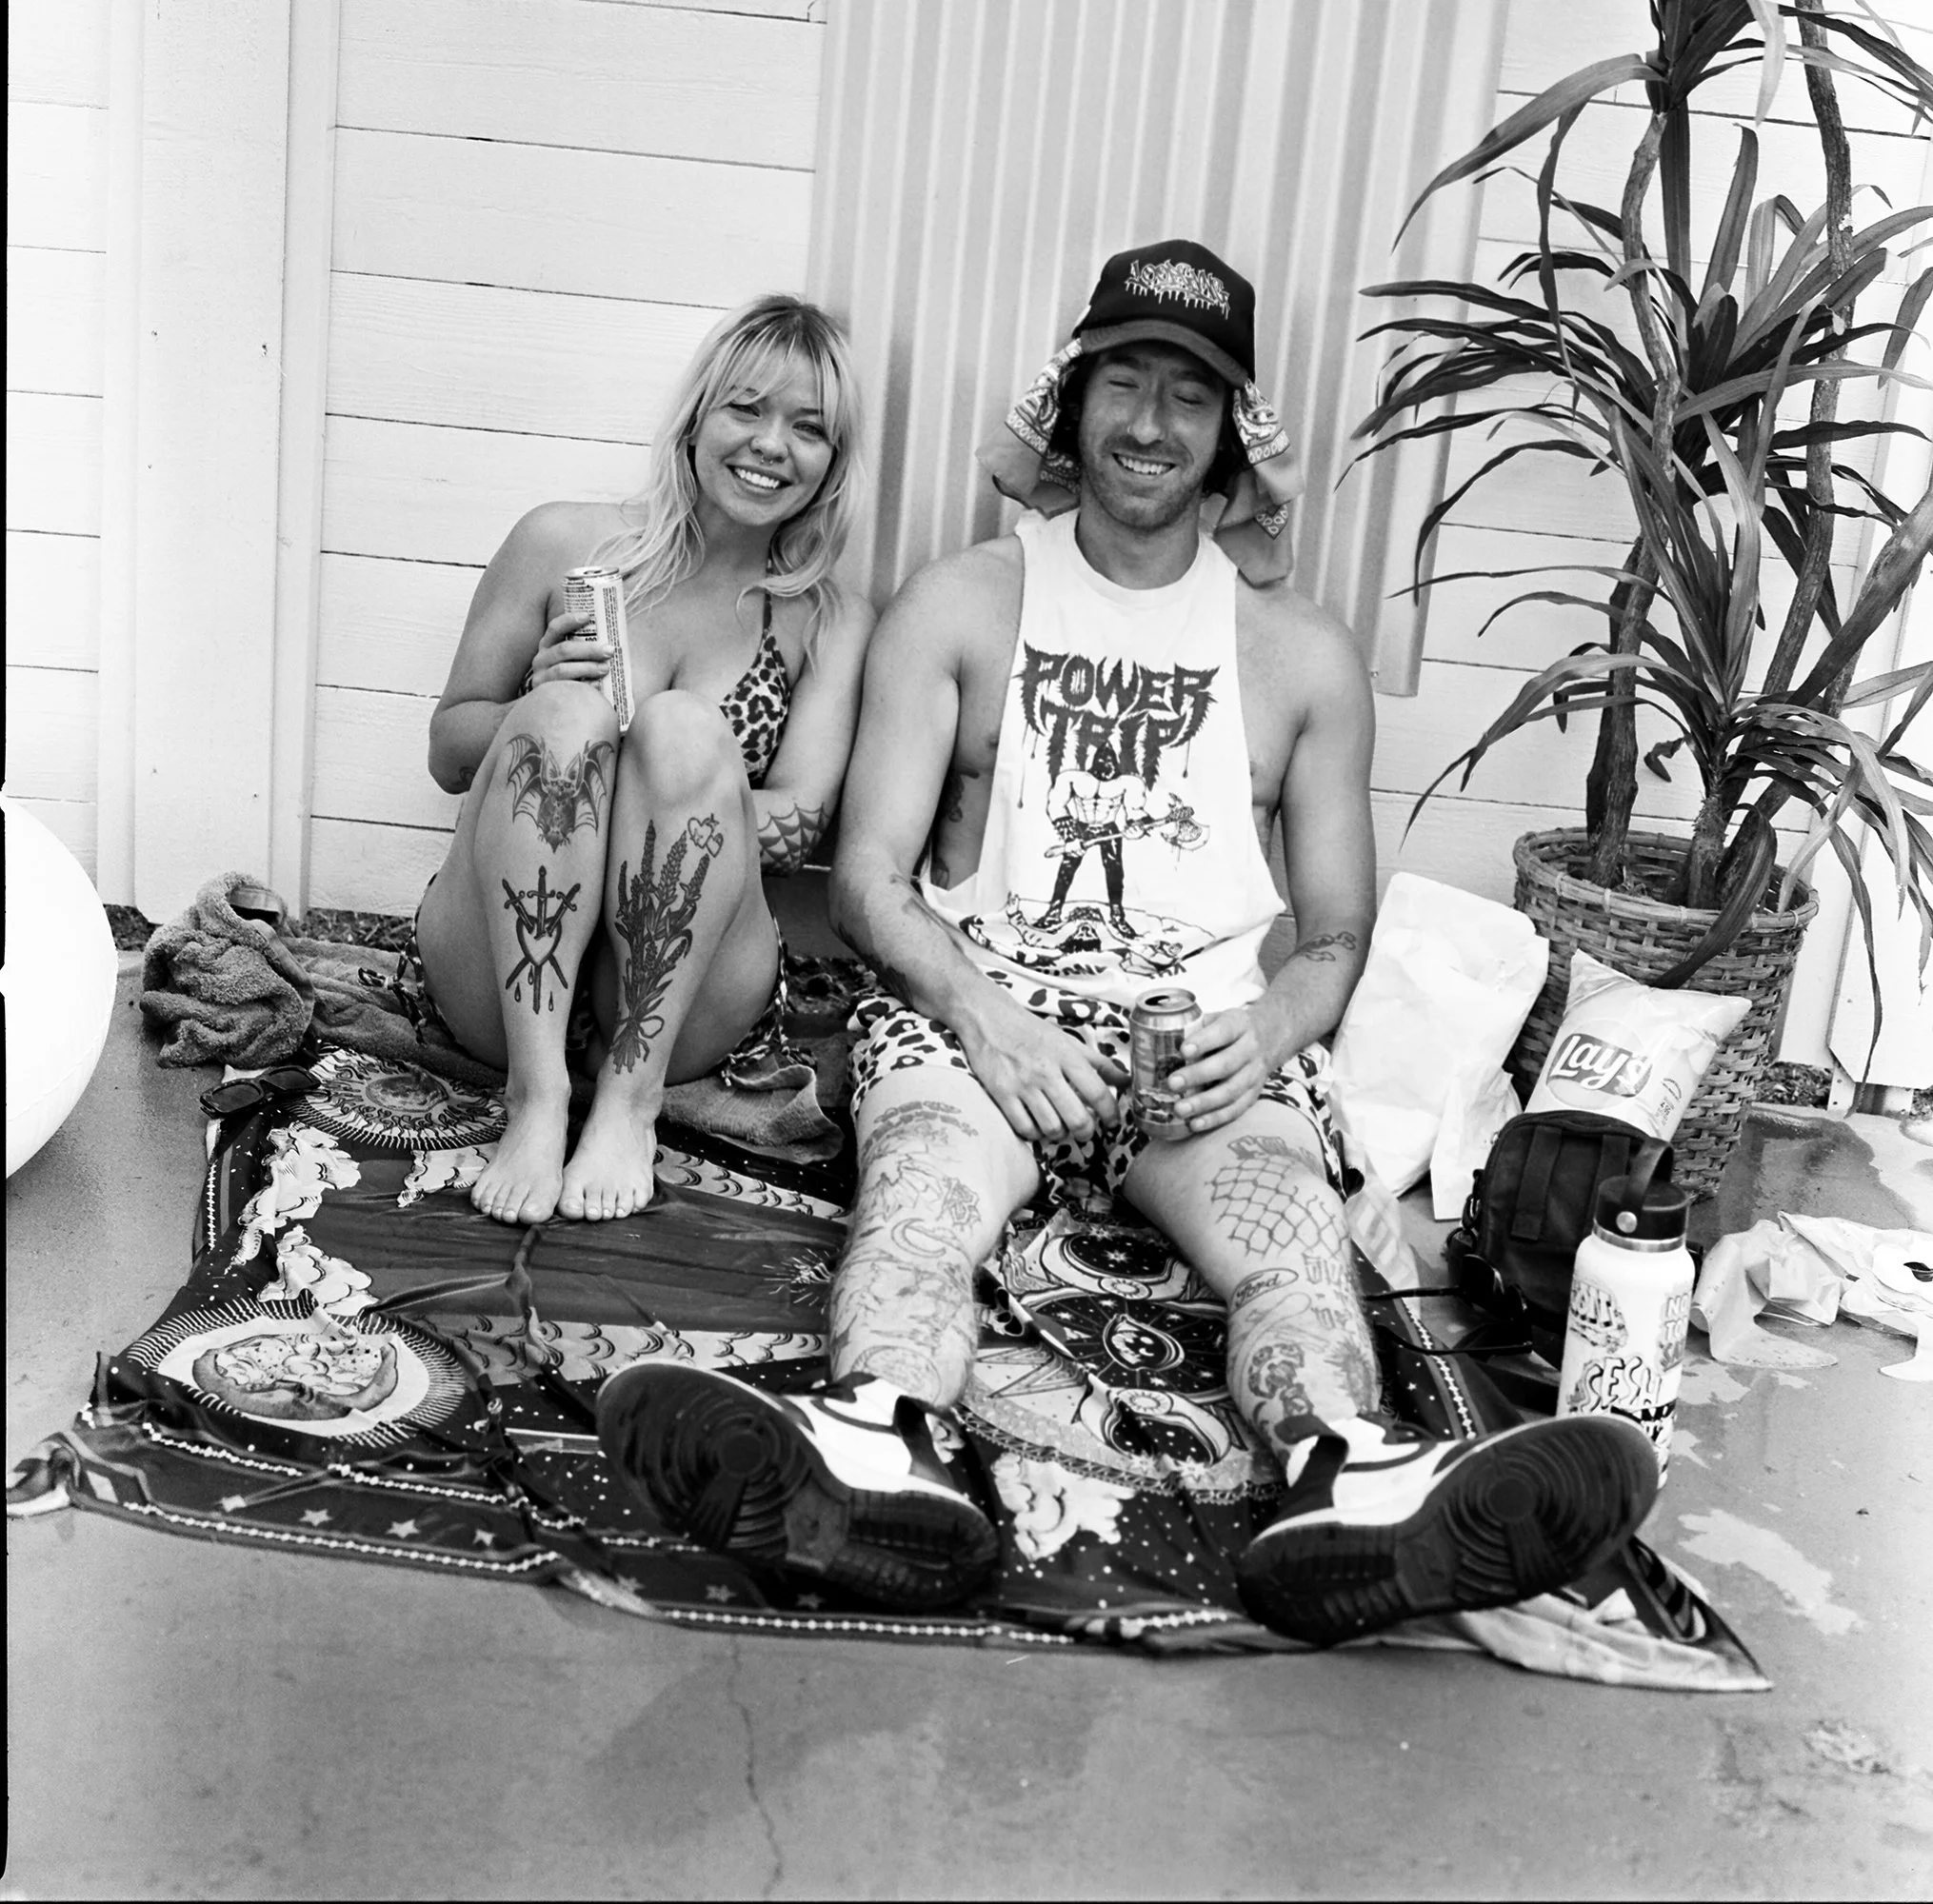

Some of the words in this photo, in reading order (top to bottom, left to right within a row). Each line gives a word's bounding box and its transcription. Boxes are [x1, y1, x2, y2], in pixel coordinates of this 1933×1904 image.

[1011, 640, 1220, 747] POWER
[1039, 694, 1187, 791] TRIP
[1235, 1273, 1282, 1307] Ford
[1579, 1356, 1663, 1413] SESH
